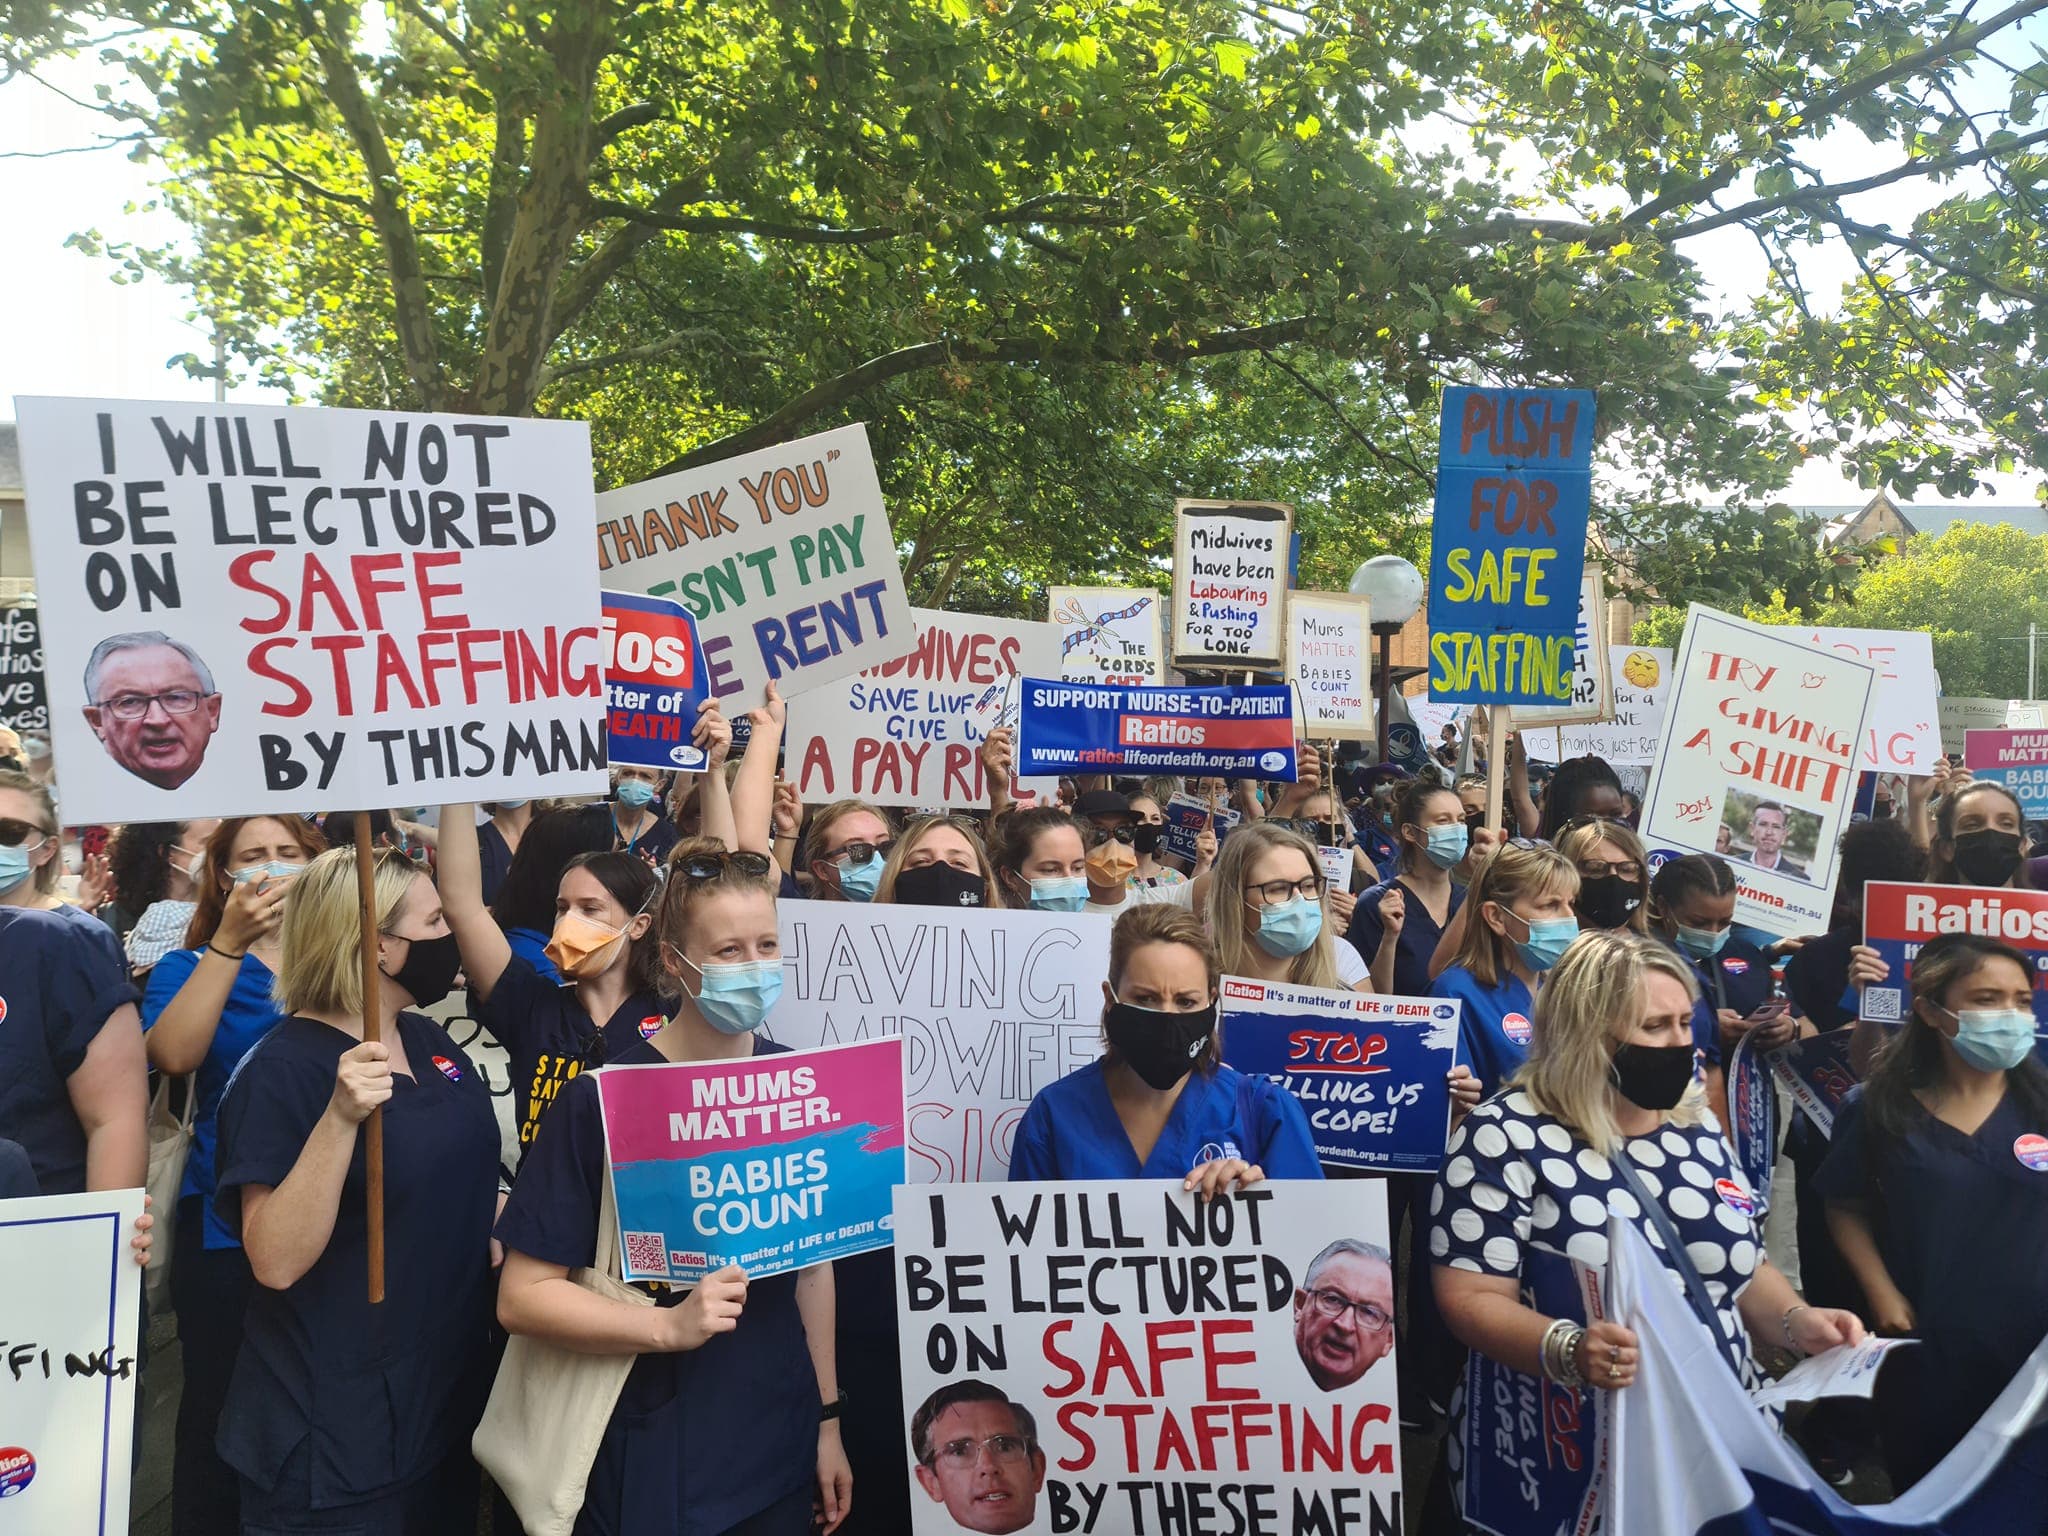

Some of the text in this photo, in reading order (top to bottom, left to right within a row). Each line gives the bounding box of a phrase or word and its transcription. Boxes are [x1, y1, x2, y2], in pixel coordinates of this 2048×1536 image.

[1458, 392, 1580, 459] PUSH
[96, 412, 511, 488] I WILL NOT
[73, 479, 557, 549] BE LECTURED
[1469, 477, 1560, 537] FOR
[596, 486, 741, 571] THANK
[1190, 525, 1274, 551] Midwives
[789, 514, 866, 587] PAY
[1192, 557, 1275, 580] have been
[85, 549, 472, 635] ON SAFE
[1190, 580, 1269, 607] Labouring
[1444, 546, 1558, 607] SAFE
[0, 608, 36, 644] fe
[752, 579, 888, 681] RENT
[1189, 603, 1258, 628] & Pushing
[1222, 626, 1253, 639] TOO
[0, 646, 44, 674] tios
[1118, 640, 1146, 655] THE
[1204, 637, 1252, 655] LONG
[1301, 641, 1356, 657] MATTER
[245, 624, 603, 718] STAFFING
[1104, 674, 1145, 687] CUT
[1300, 663, 1352, 681] BABIES
[1430, 630, 1577, 700] STAFFING
[1701, 649, 1781, 693] TRY
[656, 692, 684, 714] of
[849, 682, 919, 713] SAVE
[1033, 688, 1285, 716] SUPPORT NURSE-TO-PATIENT
[1311, 681, 1350, 692] COUNT
[1331, 696, 1362, 707] RATIOS
[1613, 686, 1655, 706] for a
[606, 711, 682, 742] EATH
[886, 714, 947, 741] GIVE
[1318, 707, 1345, 719] NOW
[1718, 696, 1852, 758] GIVING
[1124, 718, 1205, 746] Ratios
[1529, 736, 1550, 751] no
[1608, 737, 1638, 760] just
[257, 716, 609, 792] BY THIS MAN
[799, 735, 836, 795] A
[852, 737, 932, 797] PAY
[1031, 746, 1256, 769] www.ratioslifeordeath.org.au
[1682, 727, 1854, 804] A SHIFT
[1675, 795, 1713, 819] DOM
[1172, 835, 1184, 845] TO
[1905, 893, 2048, 941] Ratios
[1225, 982, 1430, 1017] Ratios It's a matter of LIFE or DEATH
[1288, 1029, 1388, 1065] STOP
[691, 1066, 817, 1108] MUMS
[1386, 1082, 1424, 1106] US
[668, 1095, 842, 1142] MATTER.
[1310, 1107, 1399, 1135] COPE!
[688, 1147, 829, 1199] BABIES
[690, 1184, 830, 1237] COUNT
[929, 1190, 1273, 1249] I WILL NOT
[672, 1253, 706, 1266] Ratios
[708, 1254, 727, 1267] It's
[730, 1256, 737, 1266] a
[740, 1247, 779, 1264] matter
[782, 1241, 795, 1254] of
[798, 1232, 823, 1250] LIFE
[825, 1232, 836, 1242] or
[838, 1219, 875, 1238] DEATH
[904, 1254, 1293, 1315] BE LECTURED
[0, 1340, 135, 1381] FING
[926, 1319, 1261, 1401] ON SAFE
[1056, 1403, 1395, 1474] STAFFING
[1047, 1479, 1108, 1536] BY
[1117, 1480, 1278, 1536] THESE
